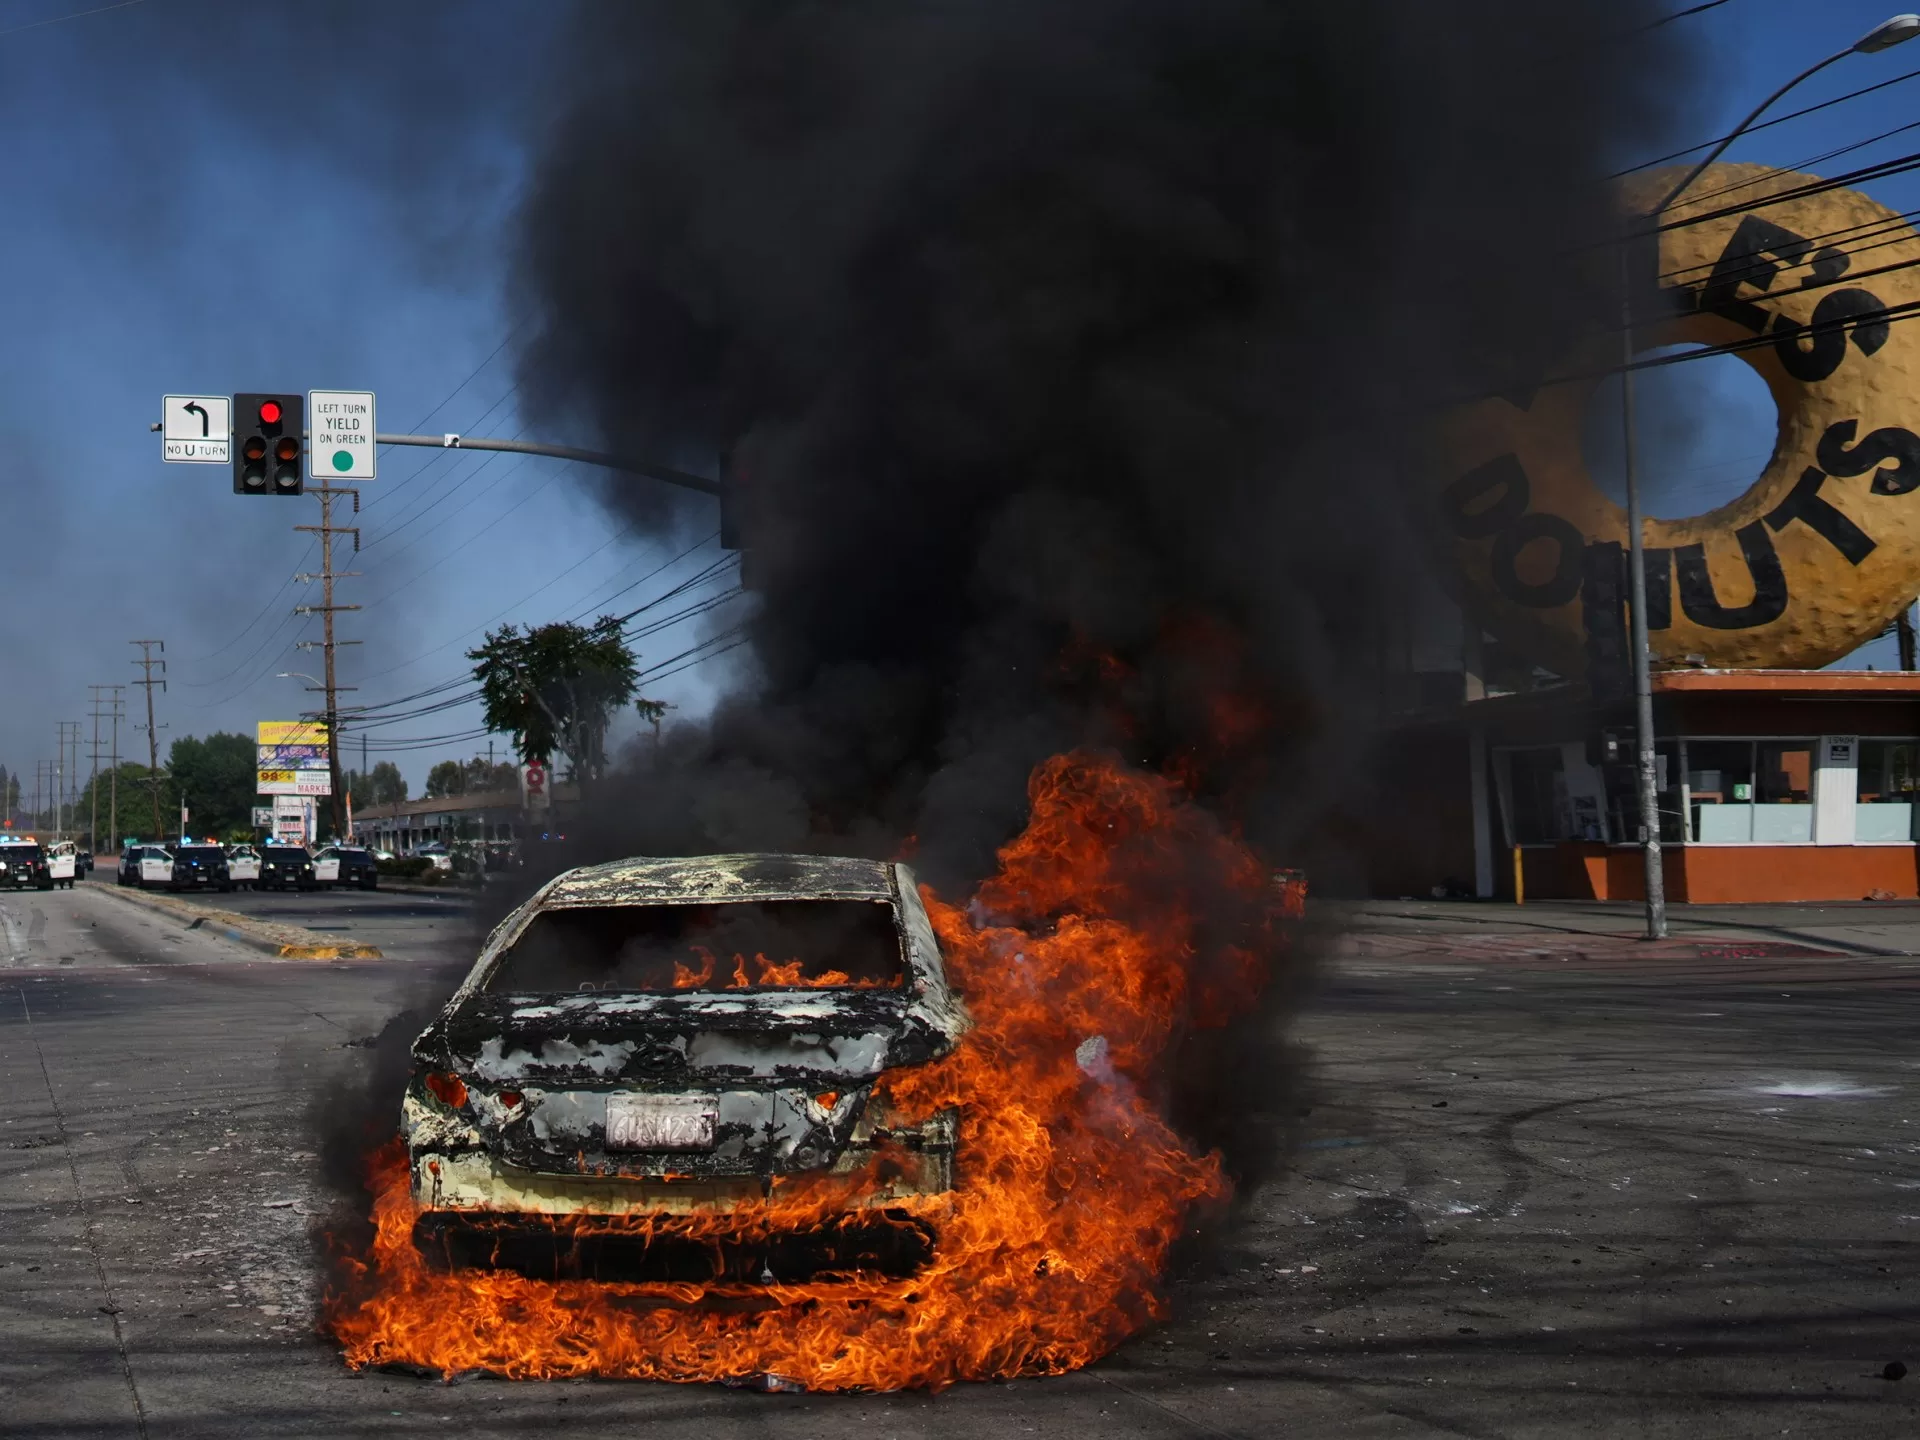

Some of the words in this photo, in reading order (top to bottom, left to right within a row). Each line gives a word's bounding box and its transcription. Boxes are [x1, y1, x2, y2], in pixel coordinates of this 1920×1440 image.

[318, 404, 339, 413] LEFT
[343, 404, 366, 414] TURN
[326, 417, 360, 430] YIELD
[320, 434, 332, 443] ON
[336, 434, 366, 444] GREEN
[167, 445, 181, 454] NO
[185, 444, 195, 456] U
[199, 446, 226, 456] TURN
[297, 784, 331, 794] MARKET
